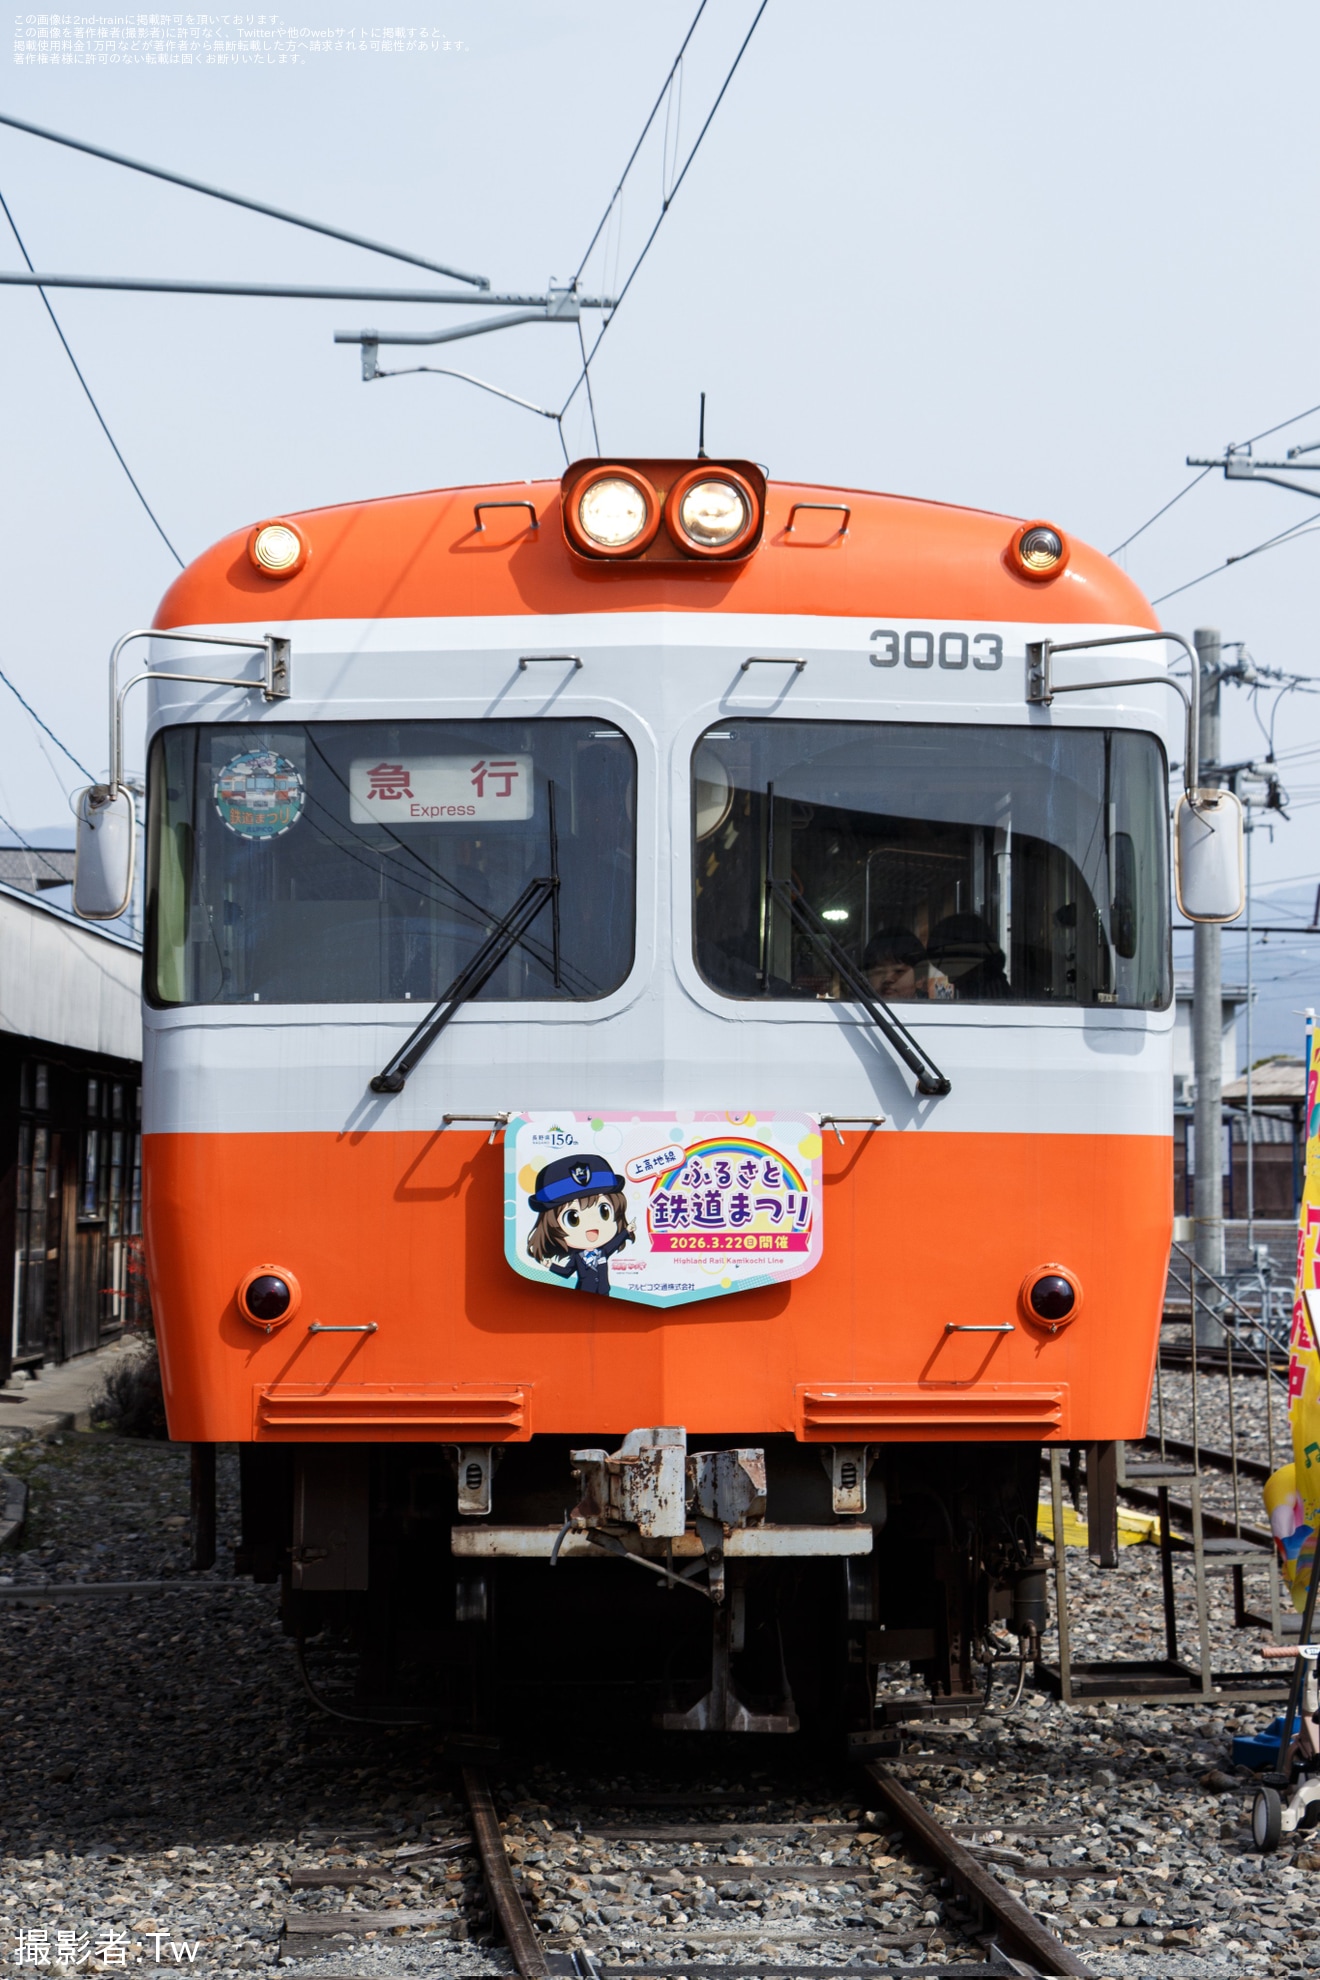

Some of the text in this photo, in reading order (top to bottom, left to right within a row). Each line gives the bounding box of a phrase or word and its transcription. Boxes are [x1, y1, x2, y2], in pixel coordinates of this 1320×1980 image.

[869, 629, 1004, 671] 3003
[229, 807, 290, 825] 鉄道まつり
[410, 803, 476, 818] Express
[634, 1150, 677, 1175] 上高地線
[682, 1160, 781, 1188] ふるさと
[651, 1190, 809, 1228] 鉄道まつり
[673, 1257, 707, 1265] Highland
[726, 1257, 766, 1265] Kamikochi
